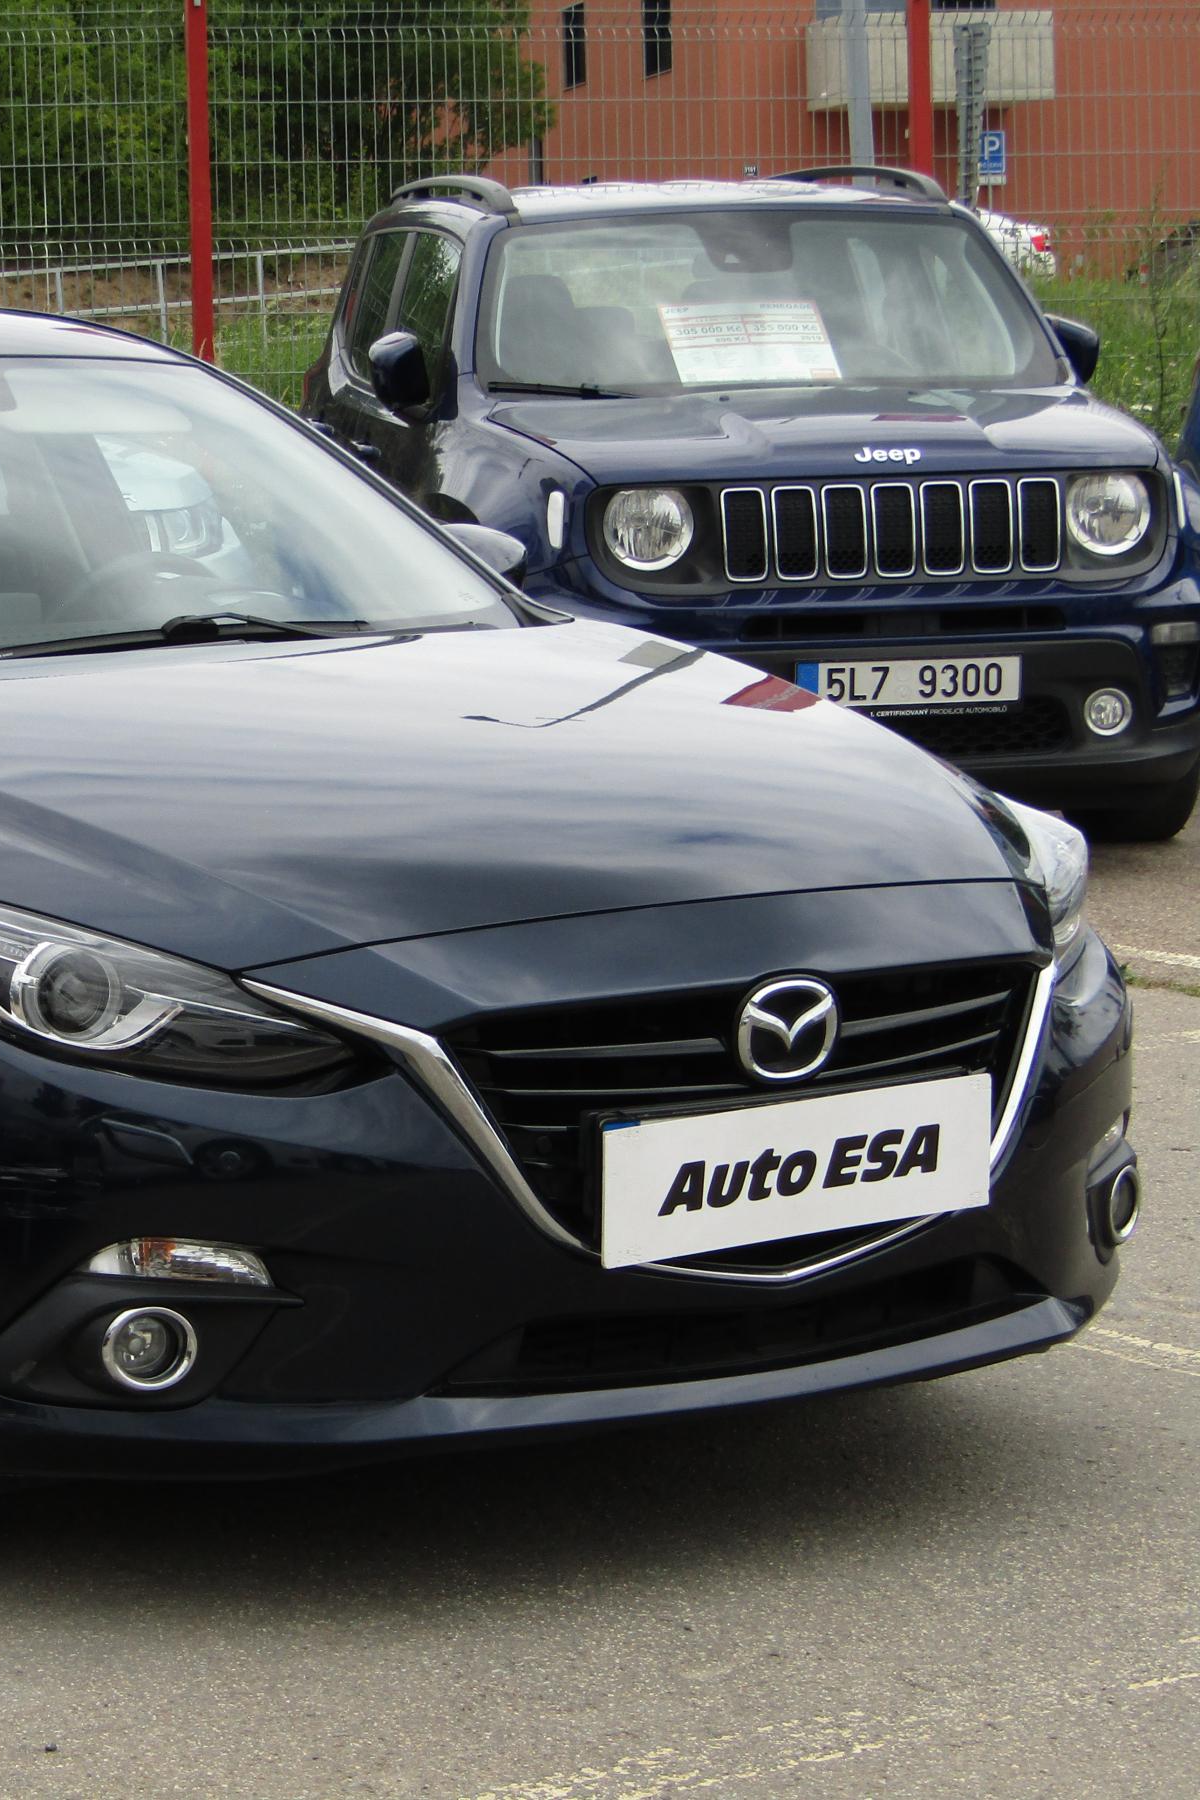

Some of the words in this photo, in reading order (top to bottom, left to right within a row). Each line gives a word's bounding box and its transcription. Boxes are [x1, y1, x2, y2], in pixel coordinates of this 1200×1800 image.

[984, 136, 1000, 160] P
[854, 446, 921, 465] Jeep
[827, 666, 890, 701] 5L7
[918, 662, 1002, 698] 9300
[876, 708, 929, 717] CERTIFIKOVANÝ
[929, 707, 964, 715] PRODEJCE
[657, 1148, 817, 1217] Auto
[822, 1123, 940, 1189] ESA
